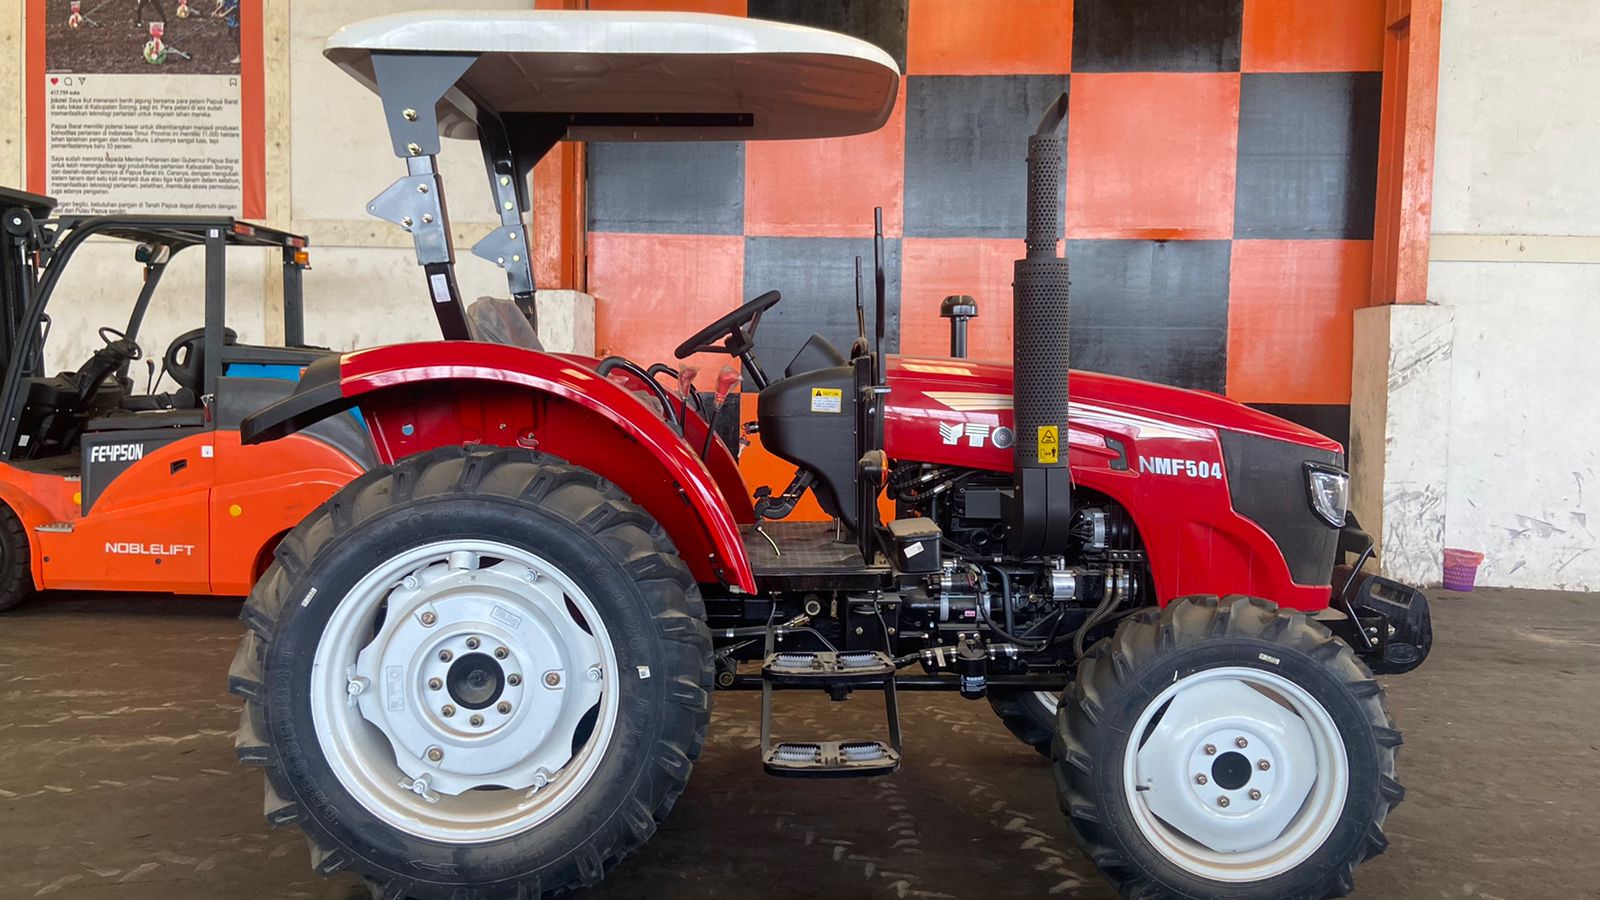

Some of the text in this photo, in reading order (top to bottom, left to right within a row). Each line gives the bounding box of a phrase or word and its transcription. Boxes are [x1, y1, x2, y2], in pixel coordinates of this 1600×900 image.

[939, 420, 1012, 449] YTO
[91, 444, 143, 462] FE4P50N
[1139, 455, 1222, 479] NMF504
[105, 542, 195, 556] NOBLELIFT
